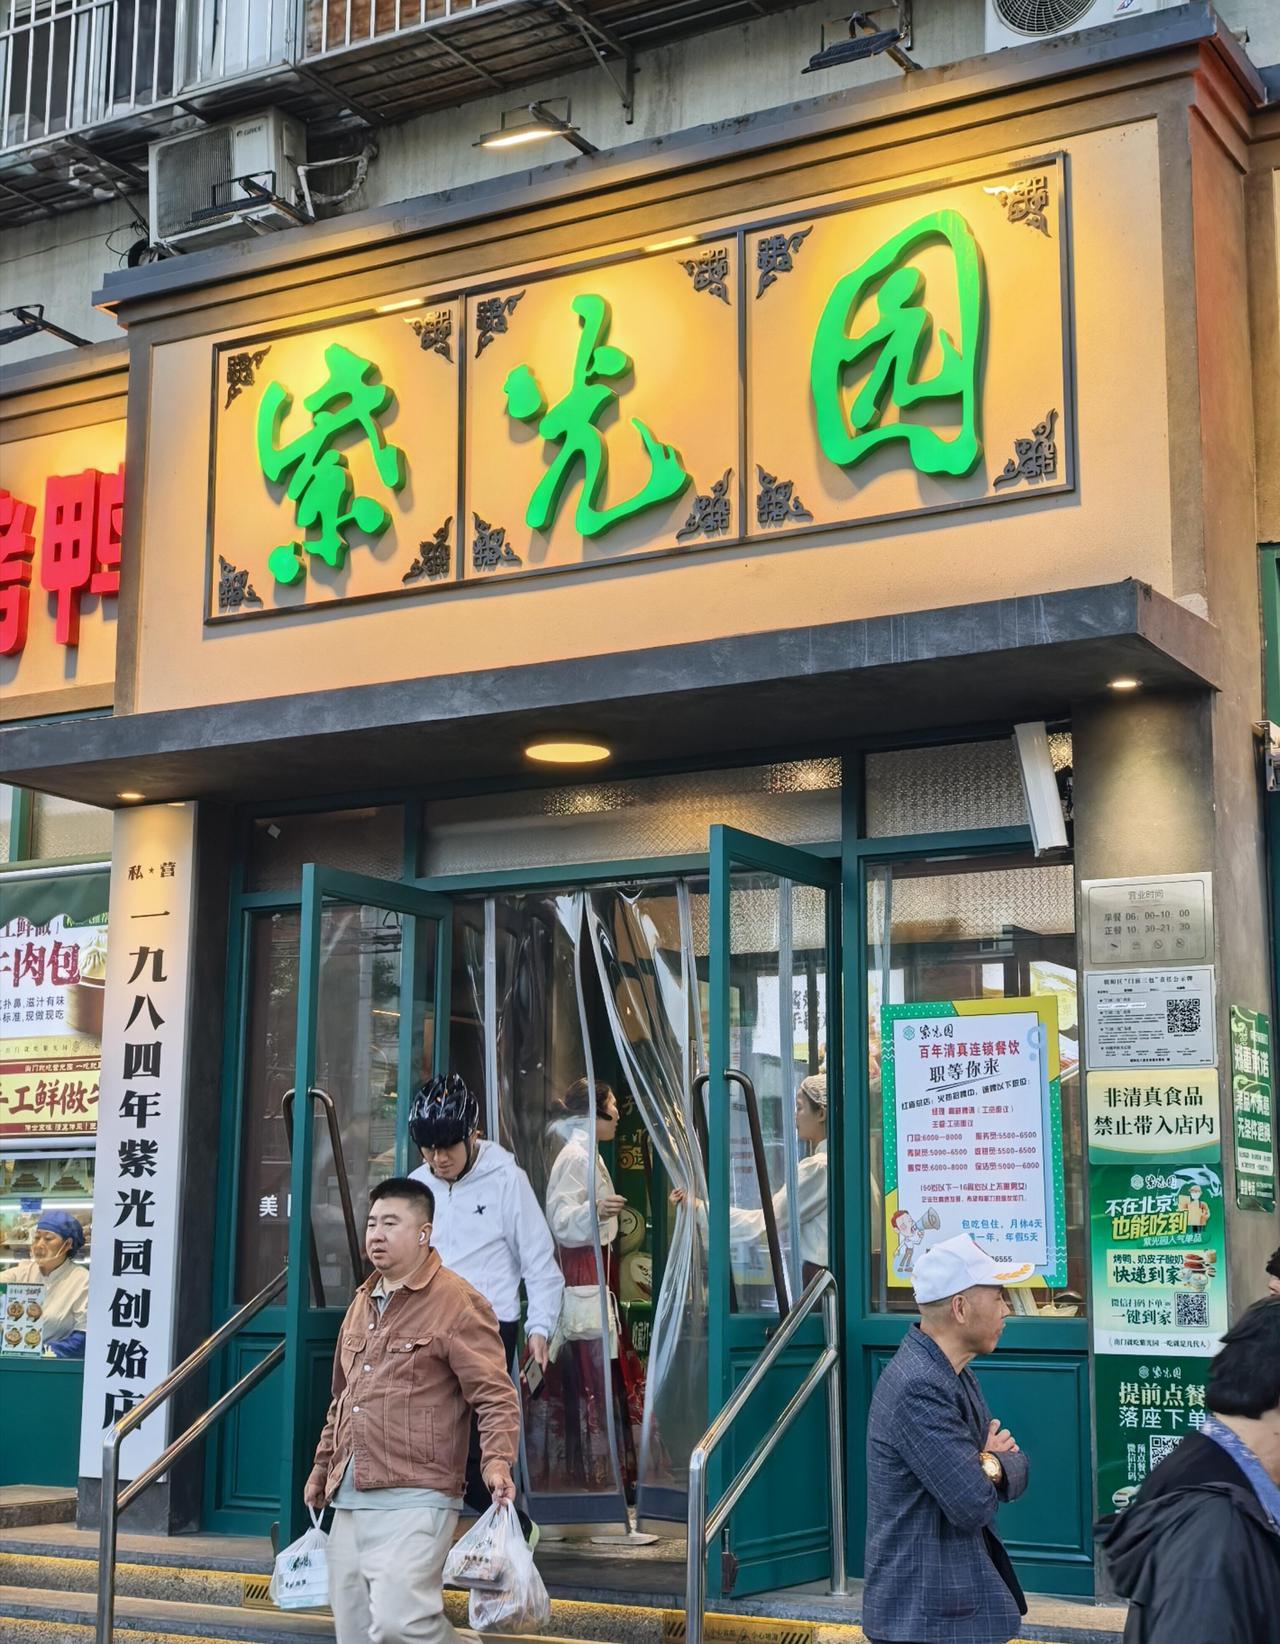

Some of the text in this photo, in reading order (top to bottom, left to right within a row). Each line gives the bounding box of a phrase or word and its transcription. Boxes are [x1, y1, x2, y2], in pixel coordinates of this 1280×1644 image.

[257, 209, 986, 586] 紫光园
[919, 1040, 1020, 1059] 百年清真连锁餐饮
[929, 1058, 1000, 1083] 职等你来
[1104, 1087, 1203, 1108] 非清真食品
[1095, 1114, 1214, 1136] 禁止带入店内
[1105, 1195, 1173, 1217] 不在北京
[1112, 1210, 1188, 1240] 也能吃到
[1113, 1253, 1184, 1264] 烤鸭、奶皮子酸奶
[1113, 1266, 1182, 1285] 快递到家
[1112, 1309, 1172, 1325] 一键到家
[1119, 1382, 1206, 1407] 提前点餐
[1119, 1406, 1206, 1429] 落座下单
